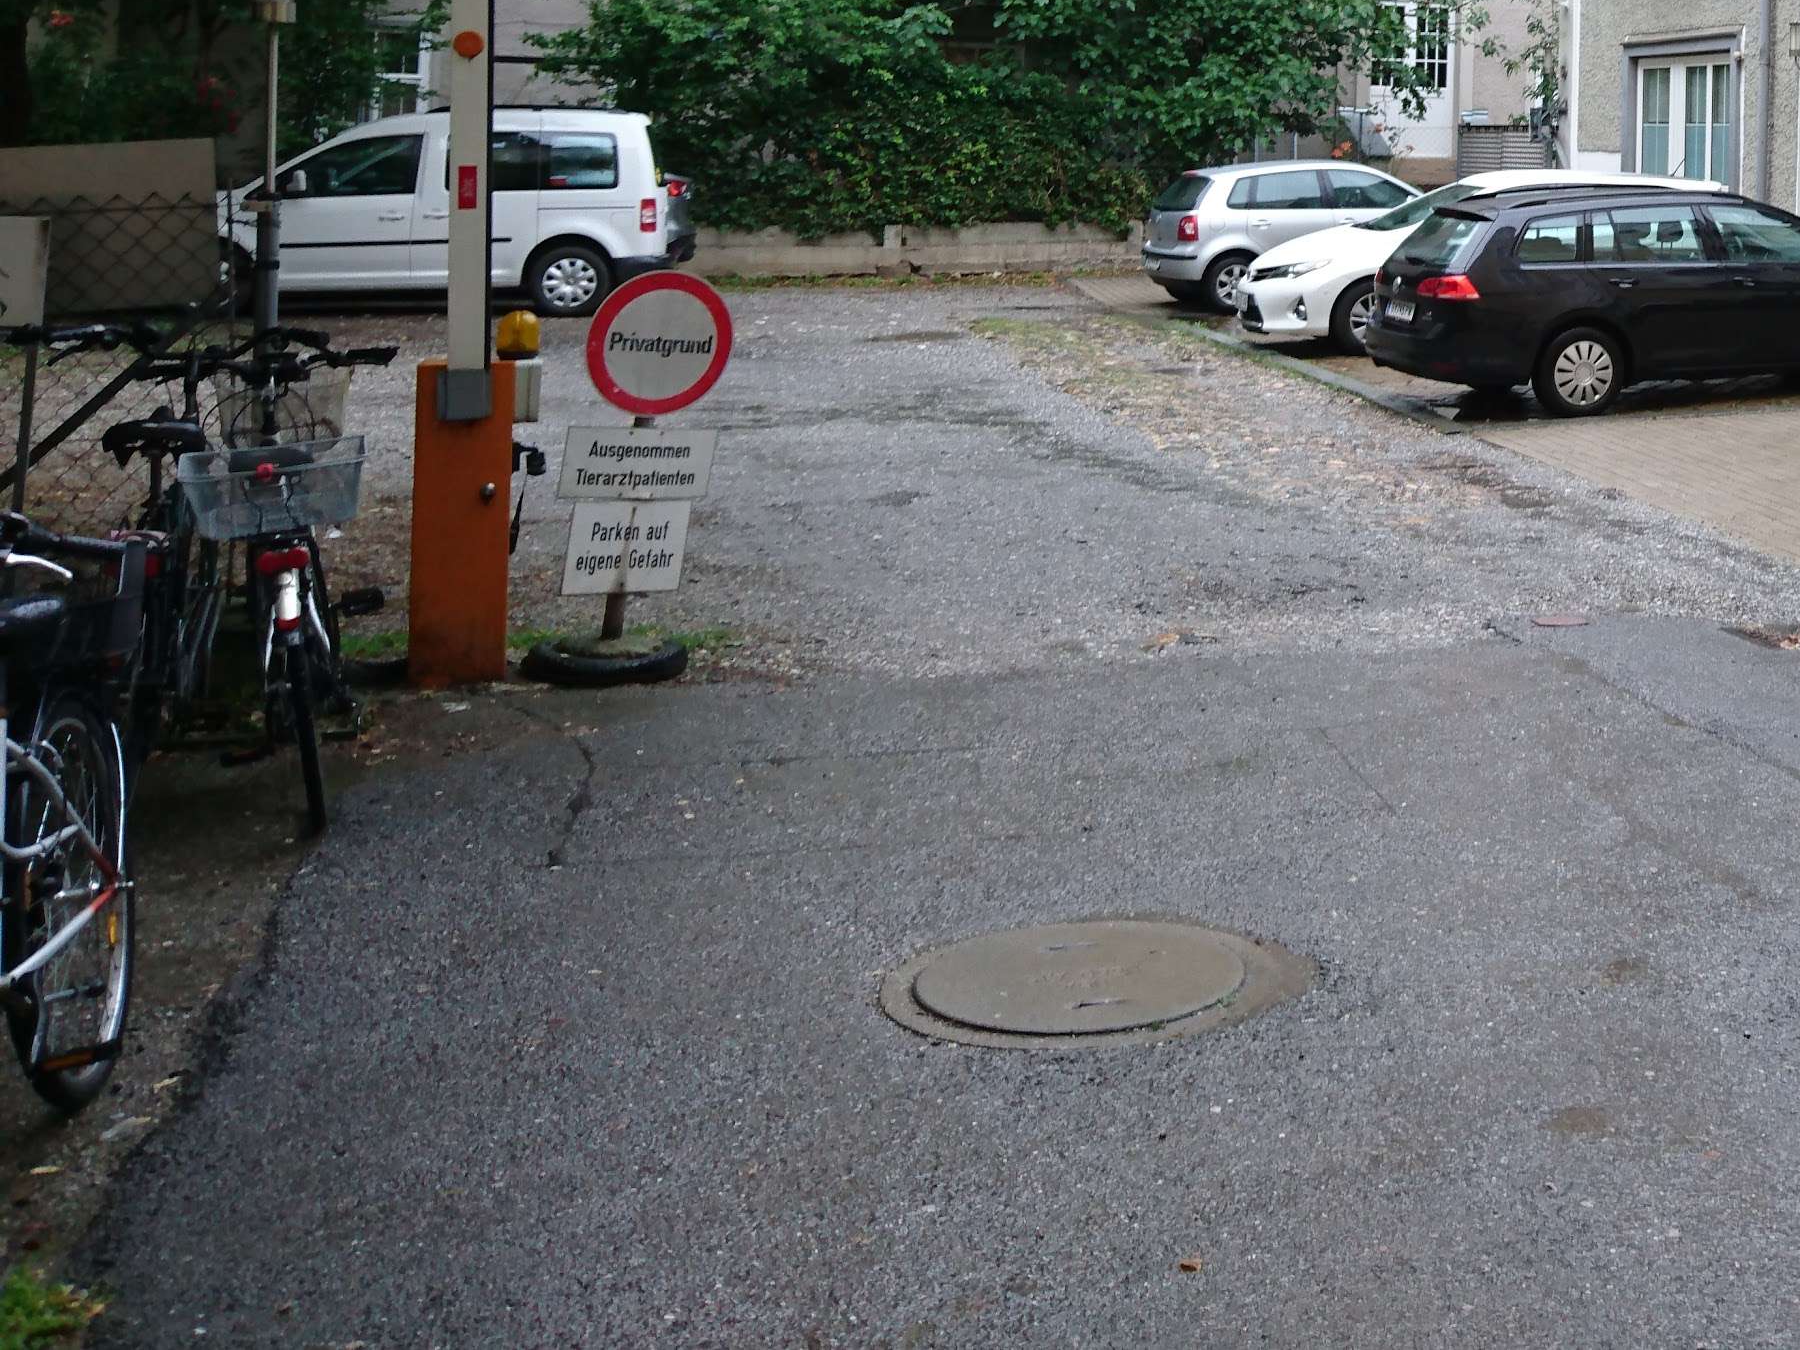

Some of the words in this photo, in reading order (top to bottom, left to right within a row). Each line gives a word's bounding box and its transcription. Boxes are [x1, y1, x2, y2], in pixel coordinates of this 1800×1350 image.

[610, 331, 713, 358] Privatgrund
[588, 440, 691, 462] Ausgenommen
[577, 468, 695, 490] Tierarztpatienten
[591, 522, 639, 541] Parken
[646, 521, 670, 541] auf
[576, 550, 622, 575] eigene
[629, 549, 674, 569] Gefahr
